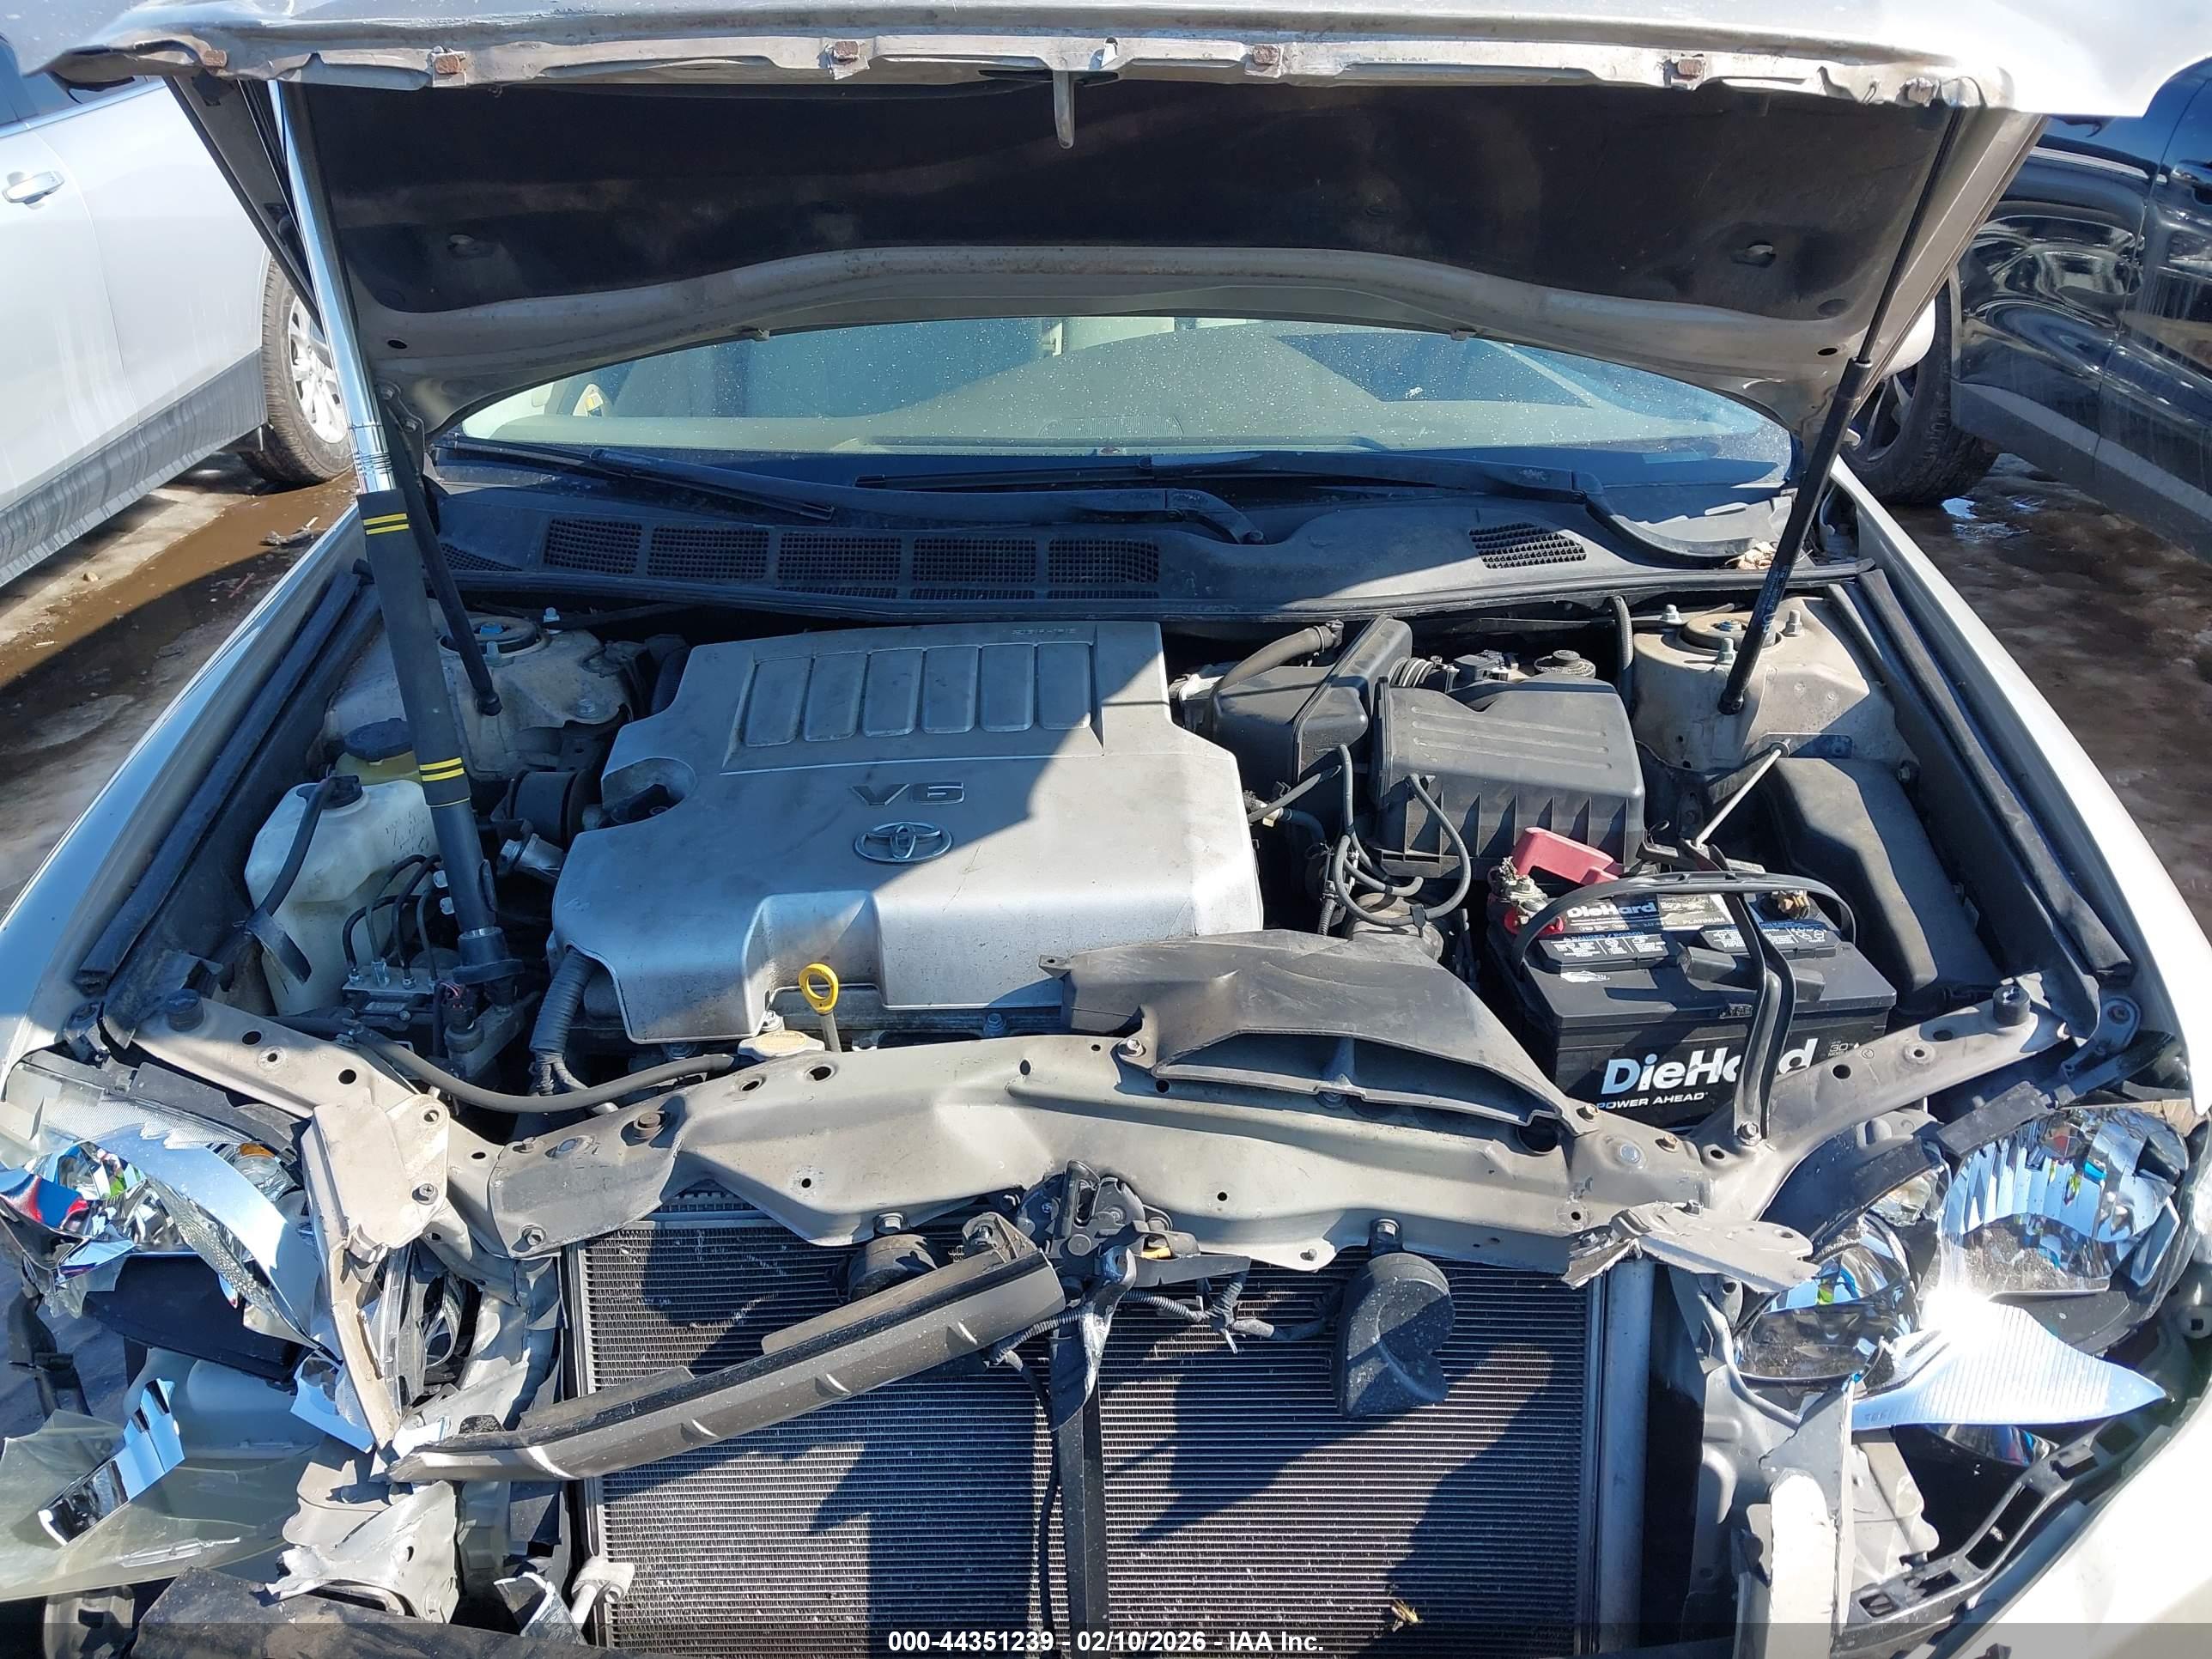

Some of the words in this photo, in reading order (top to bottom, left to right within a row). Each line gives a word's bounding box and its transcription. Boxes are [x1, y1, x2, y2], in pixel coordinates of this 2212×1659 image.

[850, 781, 964, 805] V6
[1566, 902, 1657, 918] DieHard
[1682, 916, 1726, 926] PLATINUM
[1601, 1037, 1819, 1095] DieHd
[1596, 1097, 1650, 1110] POWER
[1652, 1092, 1706, 1105] AHEAD
